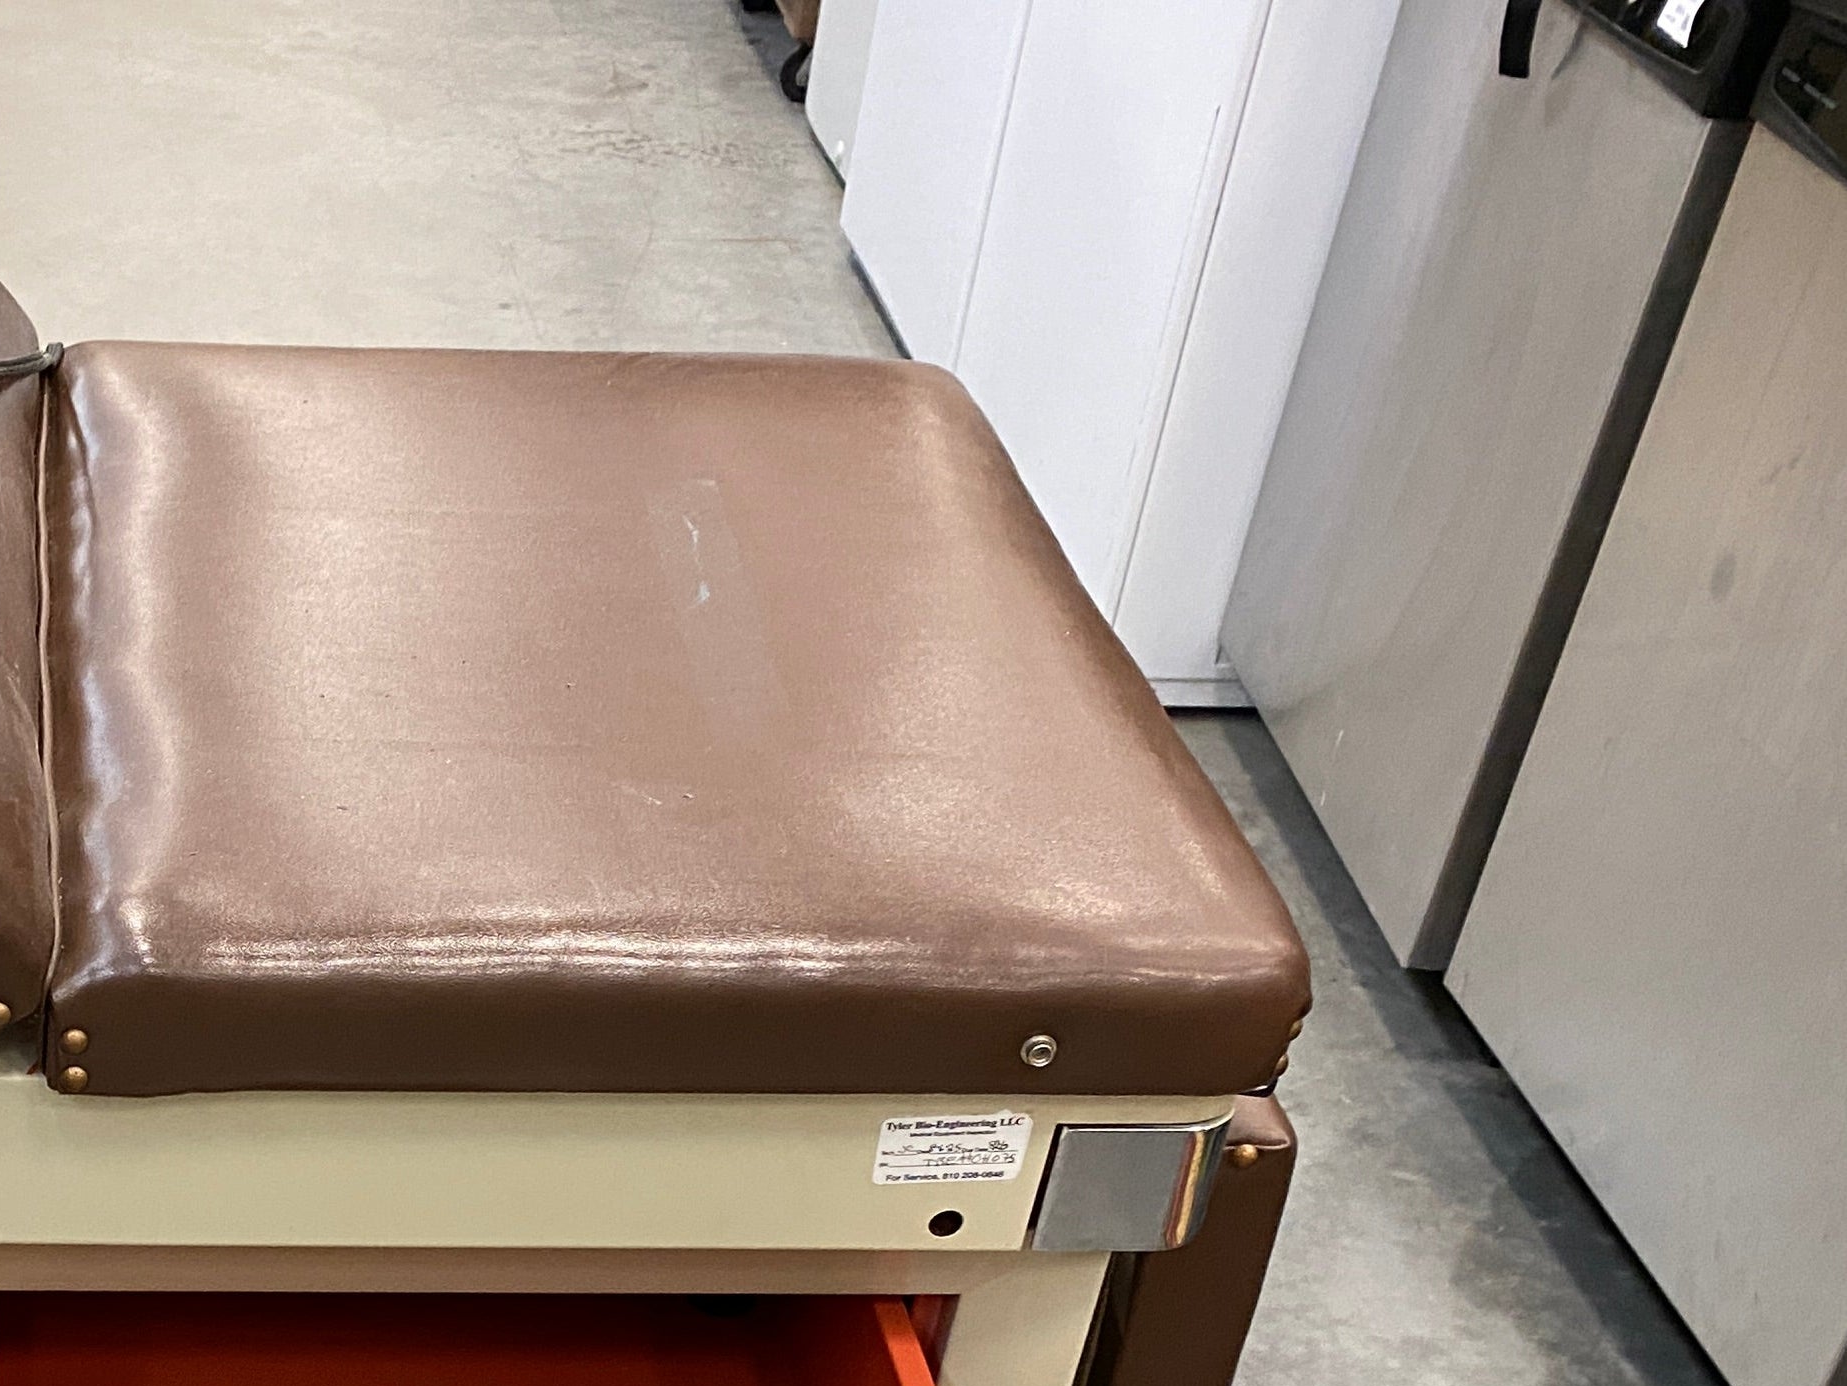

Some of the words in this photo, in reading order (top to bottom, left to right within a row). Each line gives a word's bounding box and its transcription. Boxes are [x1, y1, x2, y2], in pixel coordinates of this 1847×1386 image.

[886, 1122, 913, 1132] Tyler
[914, 1120, 997, 1130] Bio-Engineering
[1000, 1116, 1025, 1127] LLC
